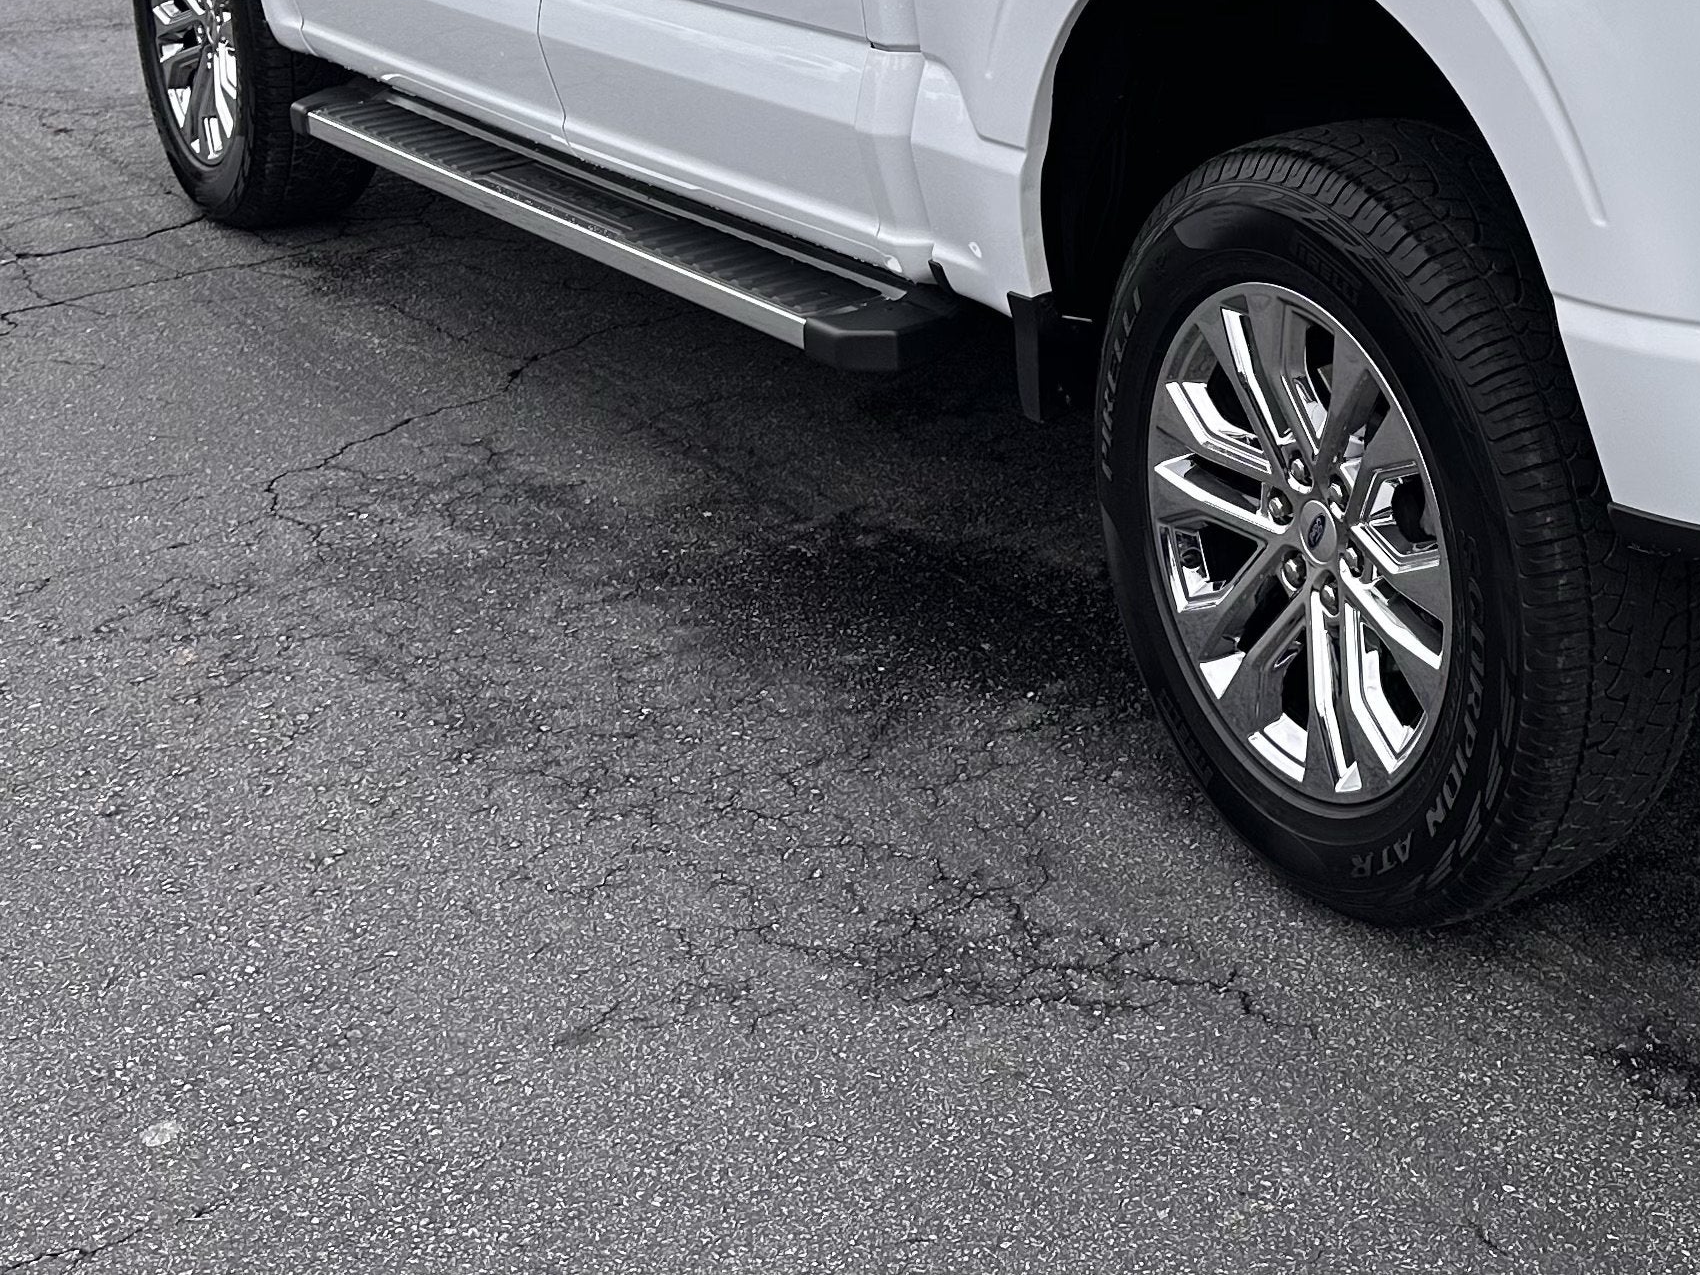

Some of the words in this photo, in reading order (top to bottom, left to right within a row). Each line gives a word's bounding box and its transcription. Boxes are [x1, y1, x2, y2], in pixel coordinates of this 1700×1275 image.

[1101, 285, 1142, 482] PIRELLI
[1426, 529, 1486, 838] SCORPION
[1351, 828, 1415, 878] ATR
